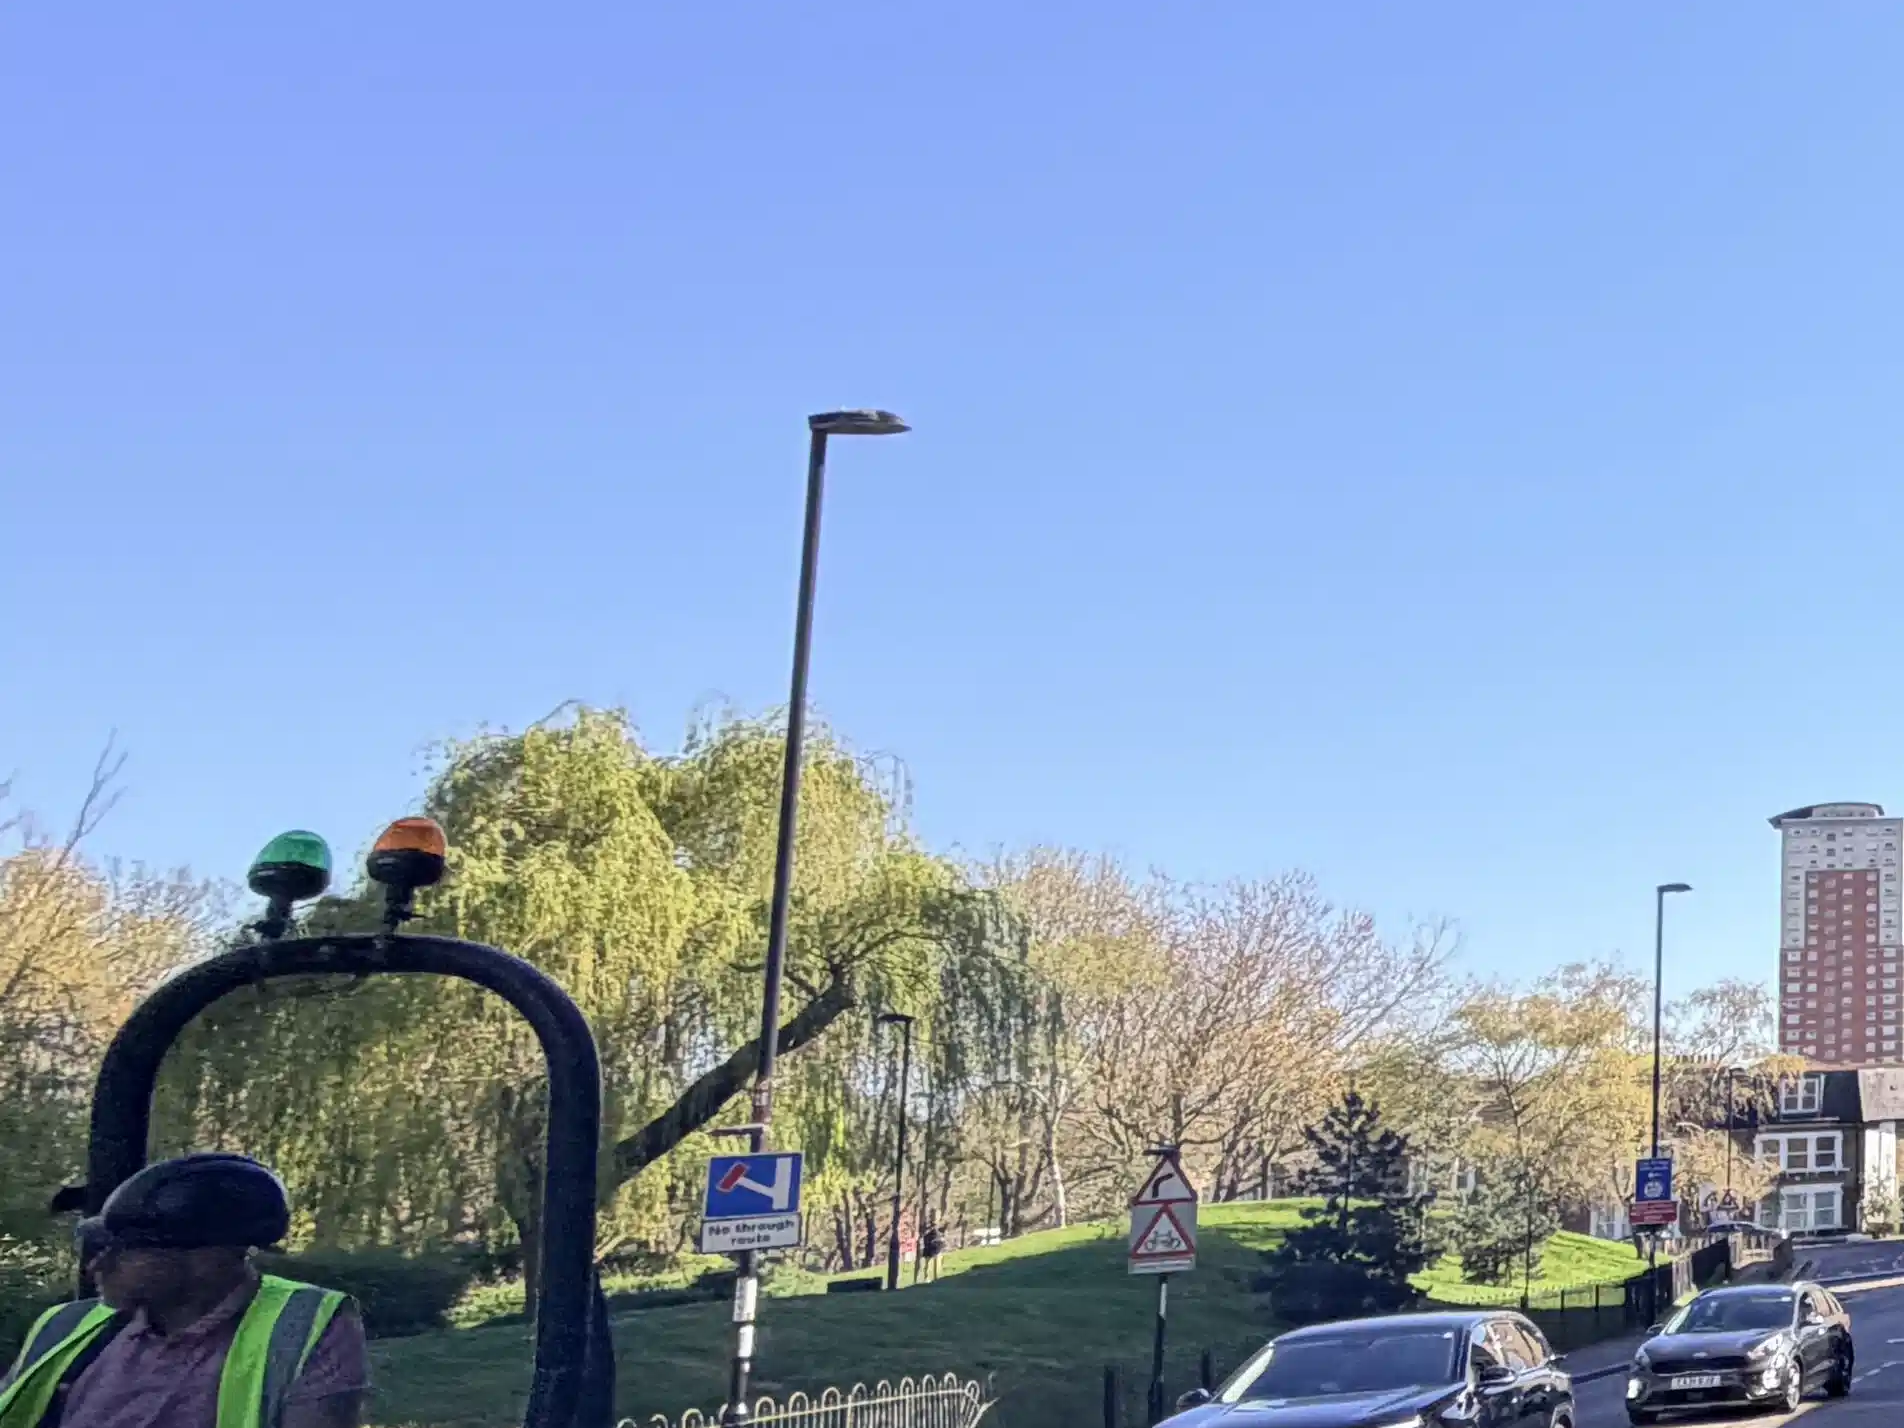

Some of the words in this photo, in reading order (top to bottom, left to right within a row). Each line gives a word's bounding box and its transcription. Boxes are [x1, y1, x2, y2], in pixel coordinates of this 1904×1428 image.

[708, 1225, 731, 1237] No
[735, 1219, 795, 1233] through
[731, 1233, 771, 1246] route
